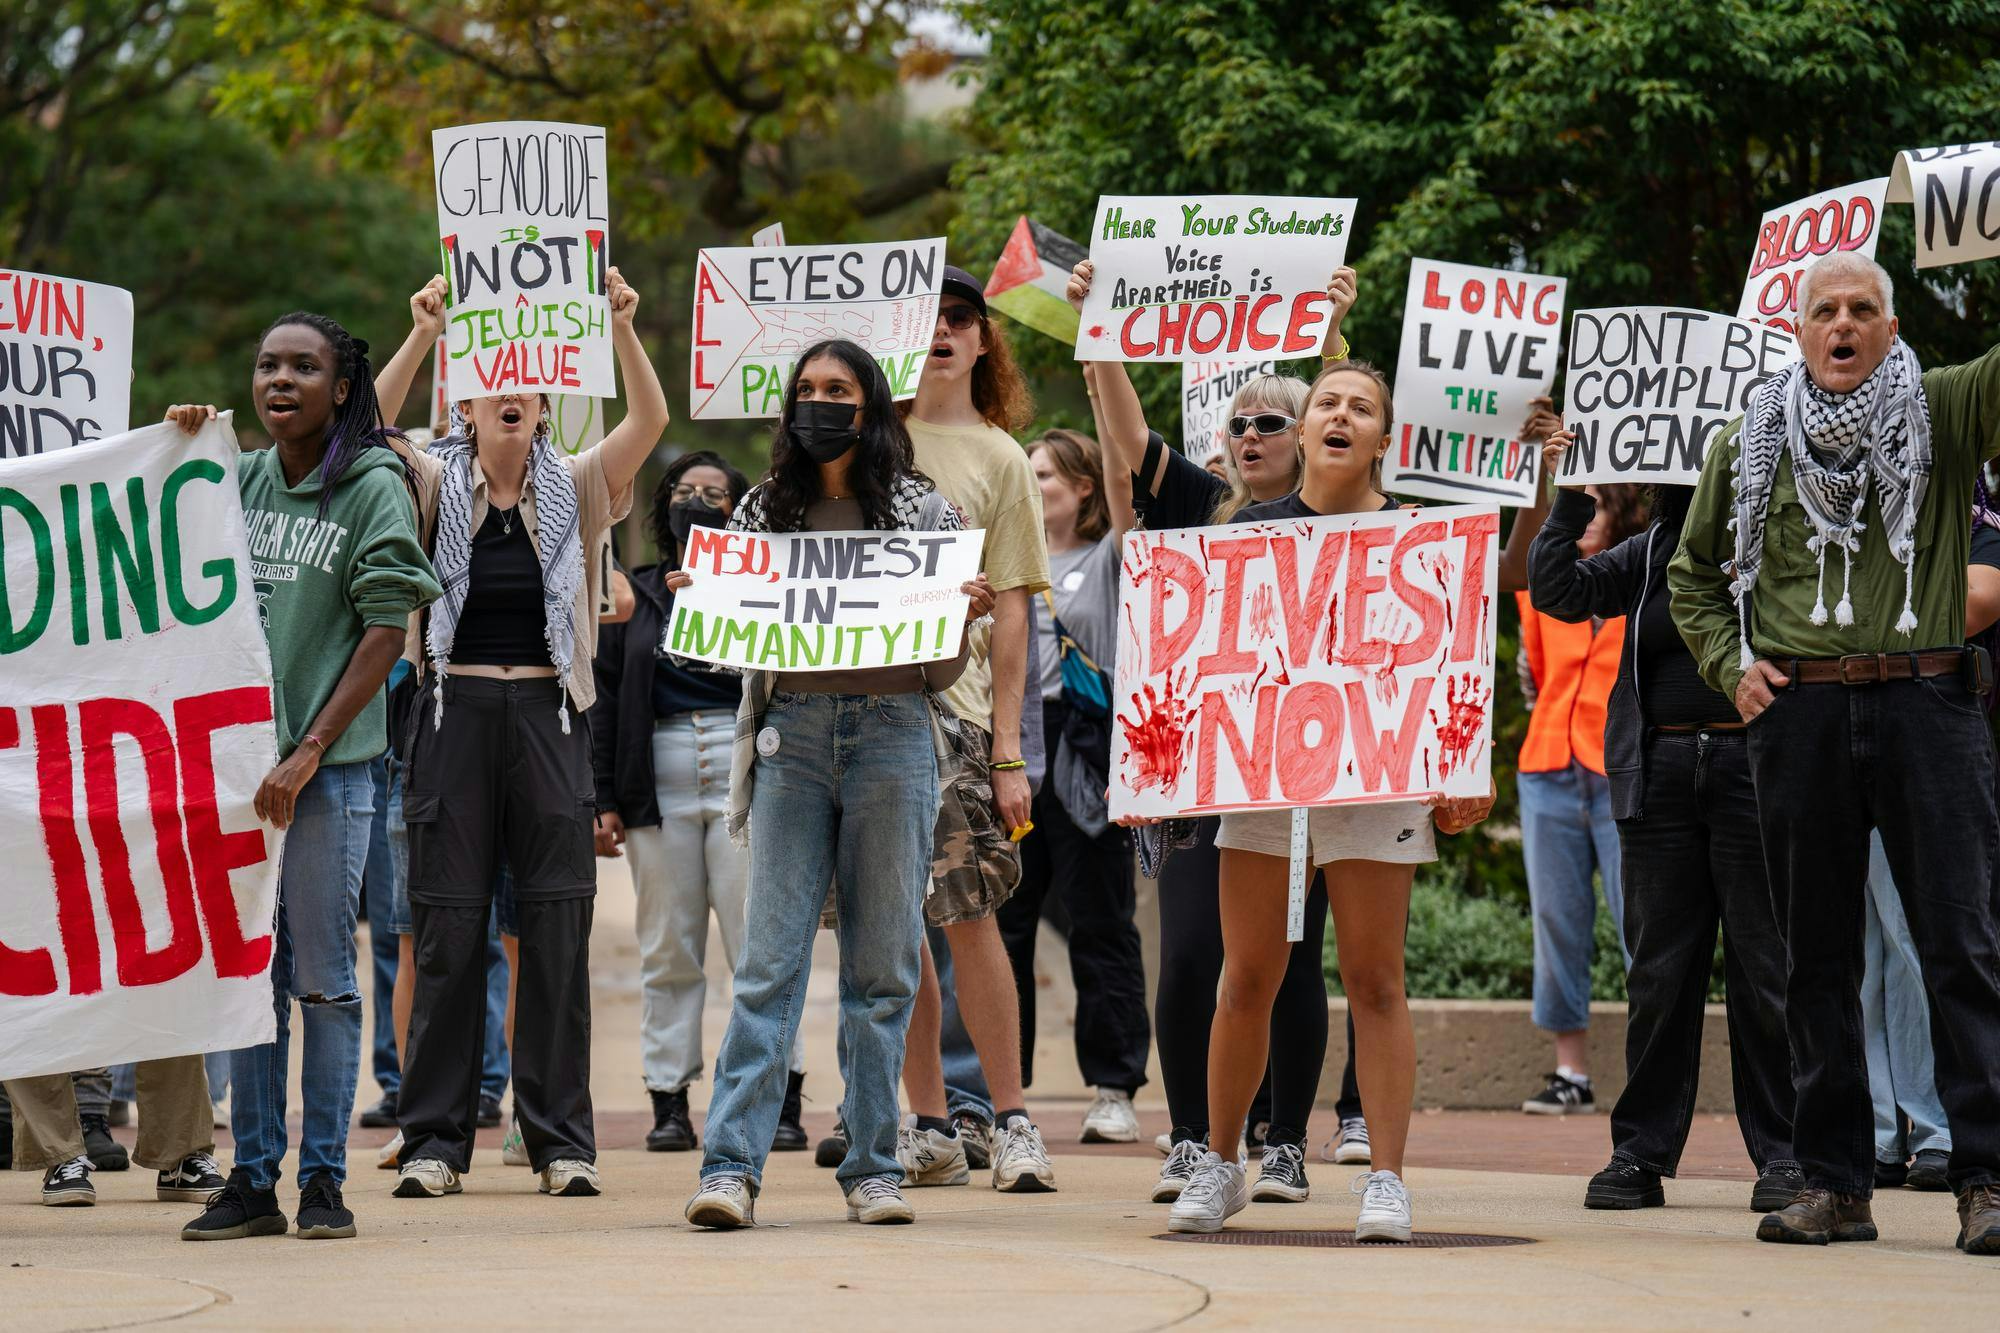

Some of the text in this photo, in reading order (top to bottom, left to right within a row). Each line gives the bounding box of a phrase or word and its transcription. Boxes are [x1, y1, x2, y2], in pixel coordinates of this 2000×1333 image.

[440, 132, 607, 221] GENOCIDE
[500, 225, 540, 243] IS
[1749, 196, 1875, 279] BLOOD
[460, 236, 578, 304] NOT
[750, 246, 936, 301] EYES ON
[1423, 271, 1559, 325] LONG
[450, 301, 605, 359] JEWISH
[1120, 291, 1329, 358] CHOICE
[1419, 323, 1547, 380] LIVE
[1570, 312, 1793, 378] DONT BE
[473, 341, 581, 391] VALUE
[1187, 405, 1225, 433] NOT
[1445, 386, 1498, 415] THE
[1187, 431, 1212, 457] WAR
[1400, 423, 1535, 484] INTIFADA
[285, 516, 348, 574] STATE
[688, 529, 956, 583] MSU, INVEST
[1149, 513, 1500, 676] DIVEST
[671, 607, 947, 668] HUMANITY!!
[1196, 676, 1436, 806] NOW
